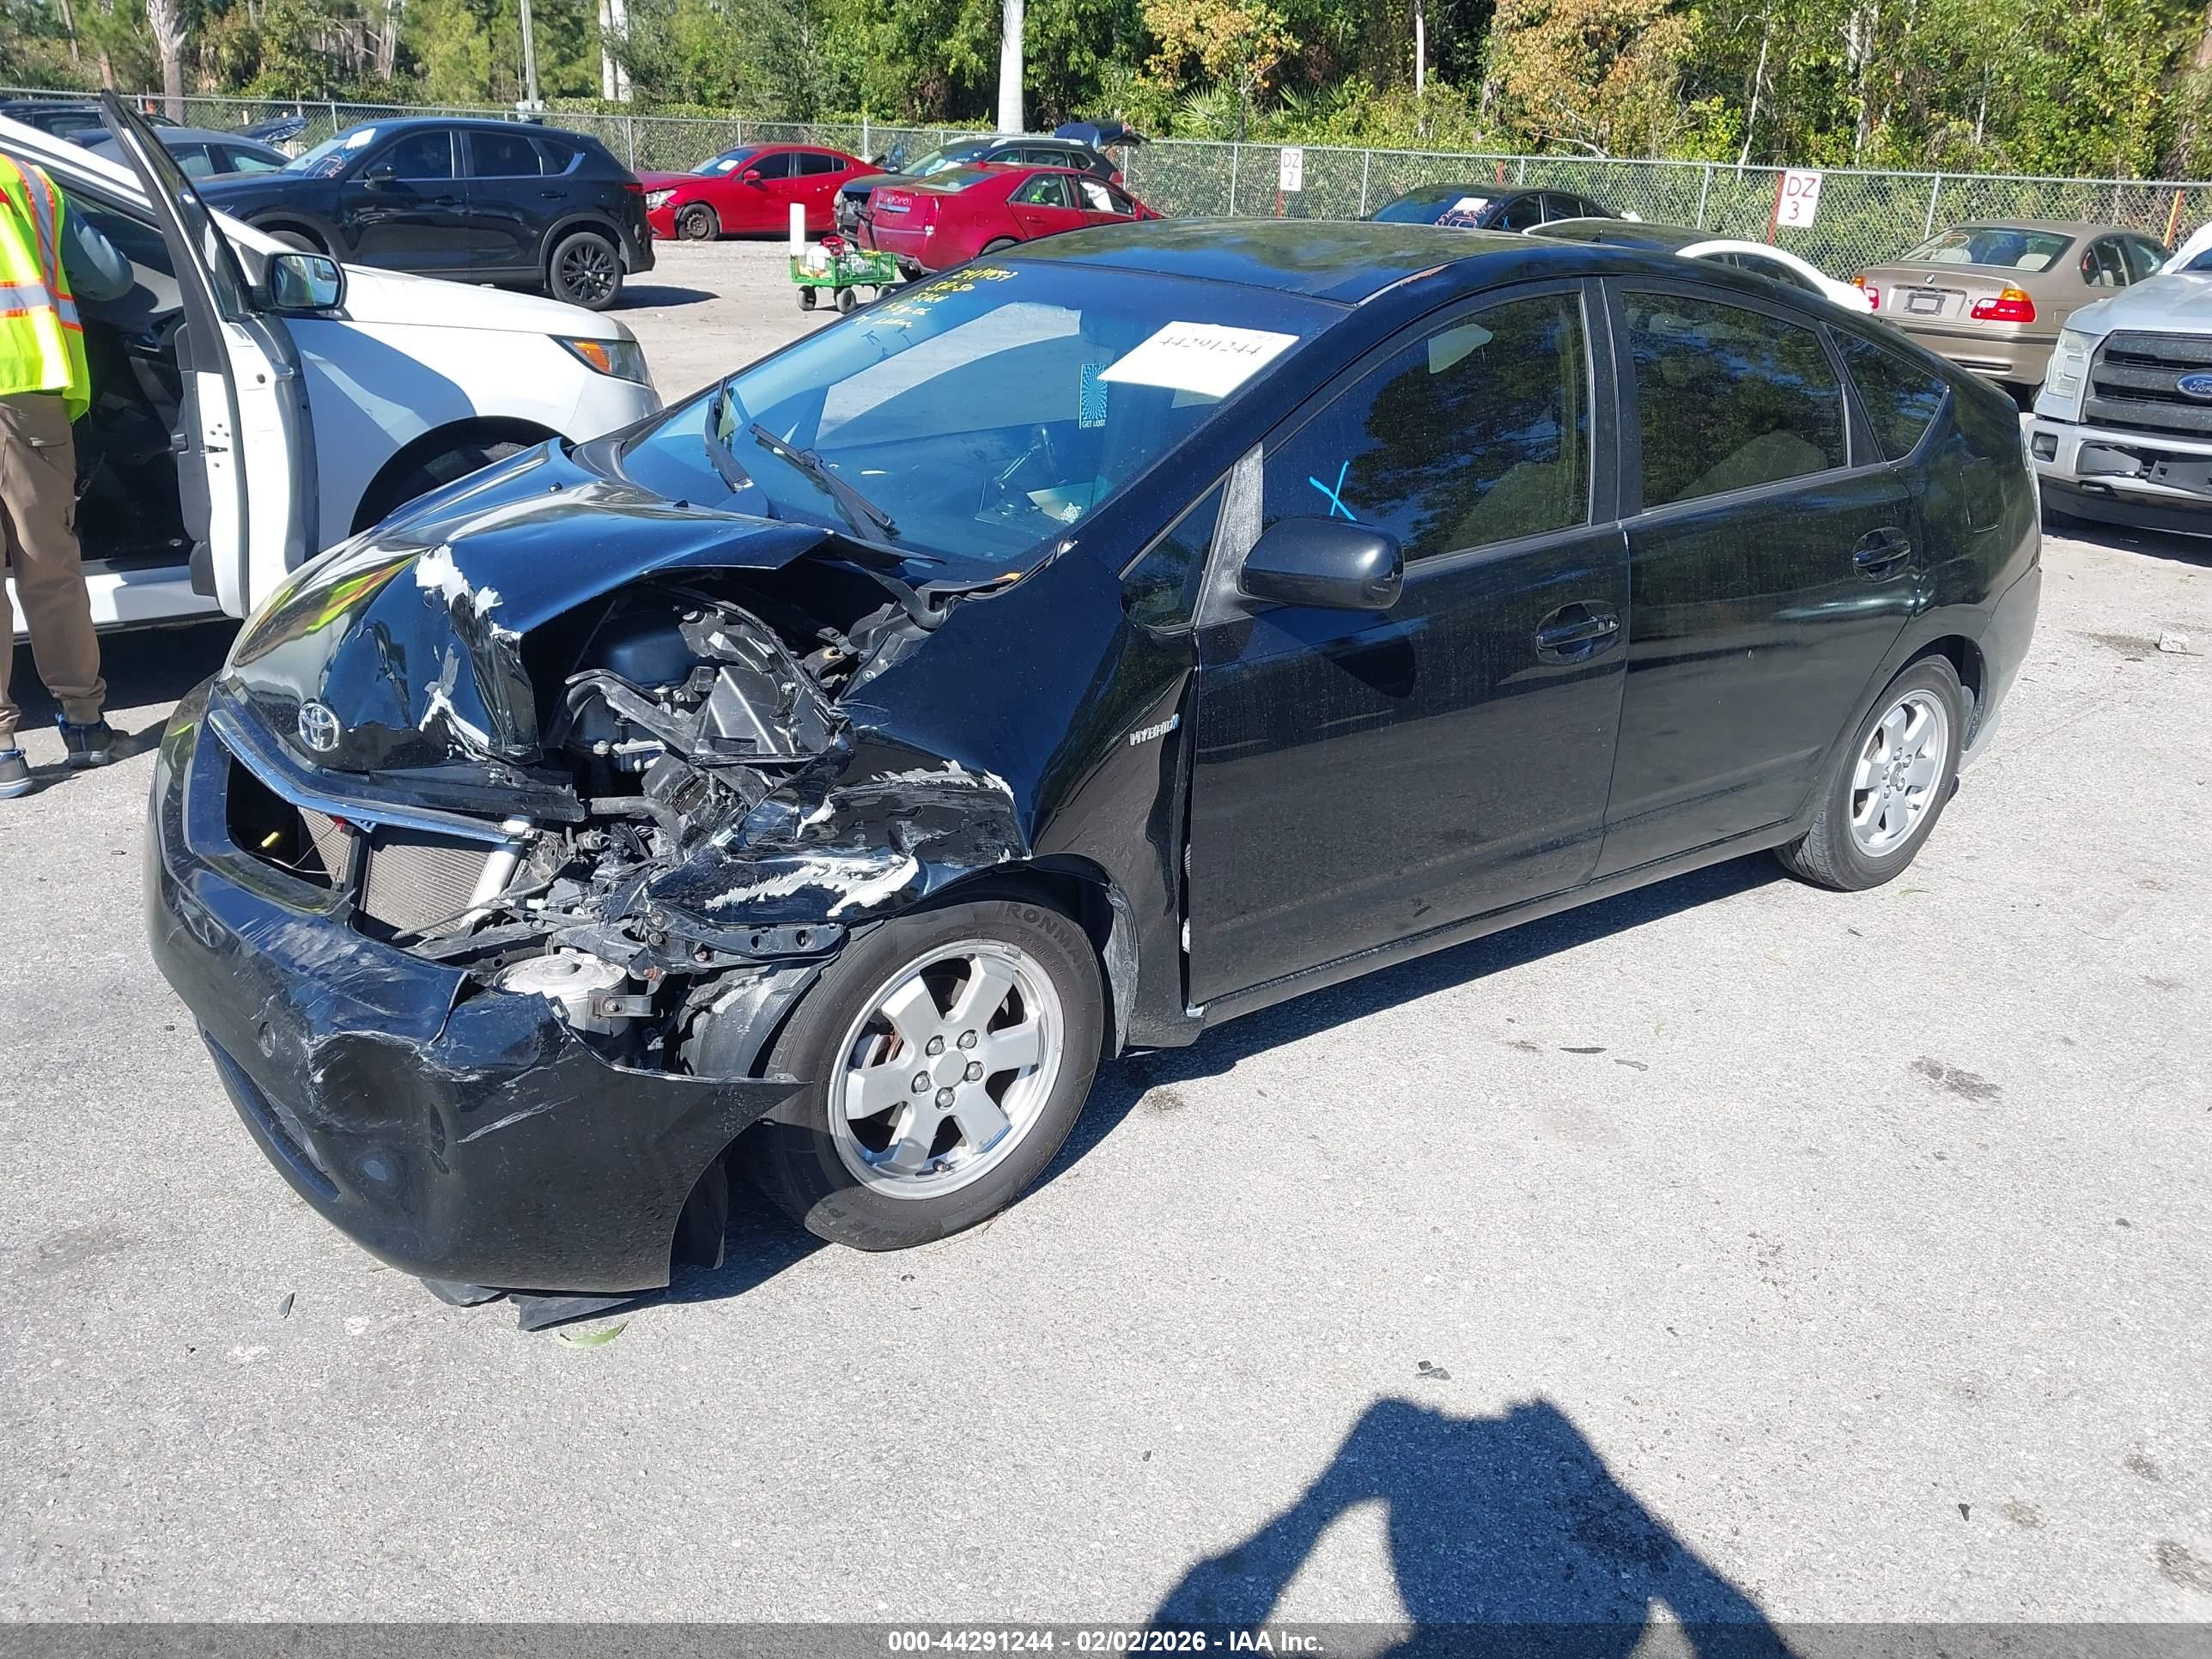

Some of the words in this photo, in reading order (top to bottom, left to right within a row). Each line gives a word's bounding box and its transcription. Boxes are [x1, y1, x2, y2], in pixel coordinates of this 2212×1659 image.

[1283, 152, 1300, 168] DZ
[1287, 171, 1294, 186] 2
[1786, 175, 1817, 198] DZ
[1788, 200, 1800, 221] 3
[1129, 719, 1174, 746] HYBRID
